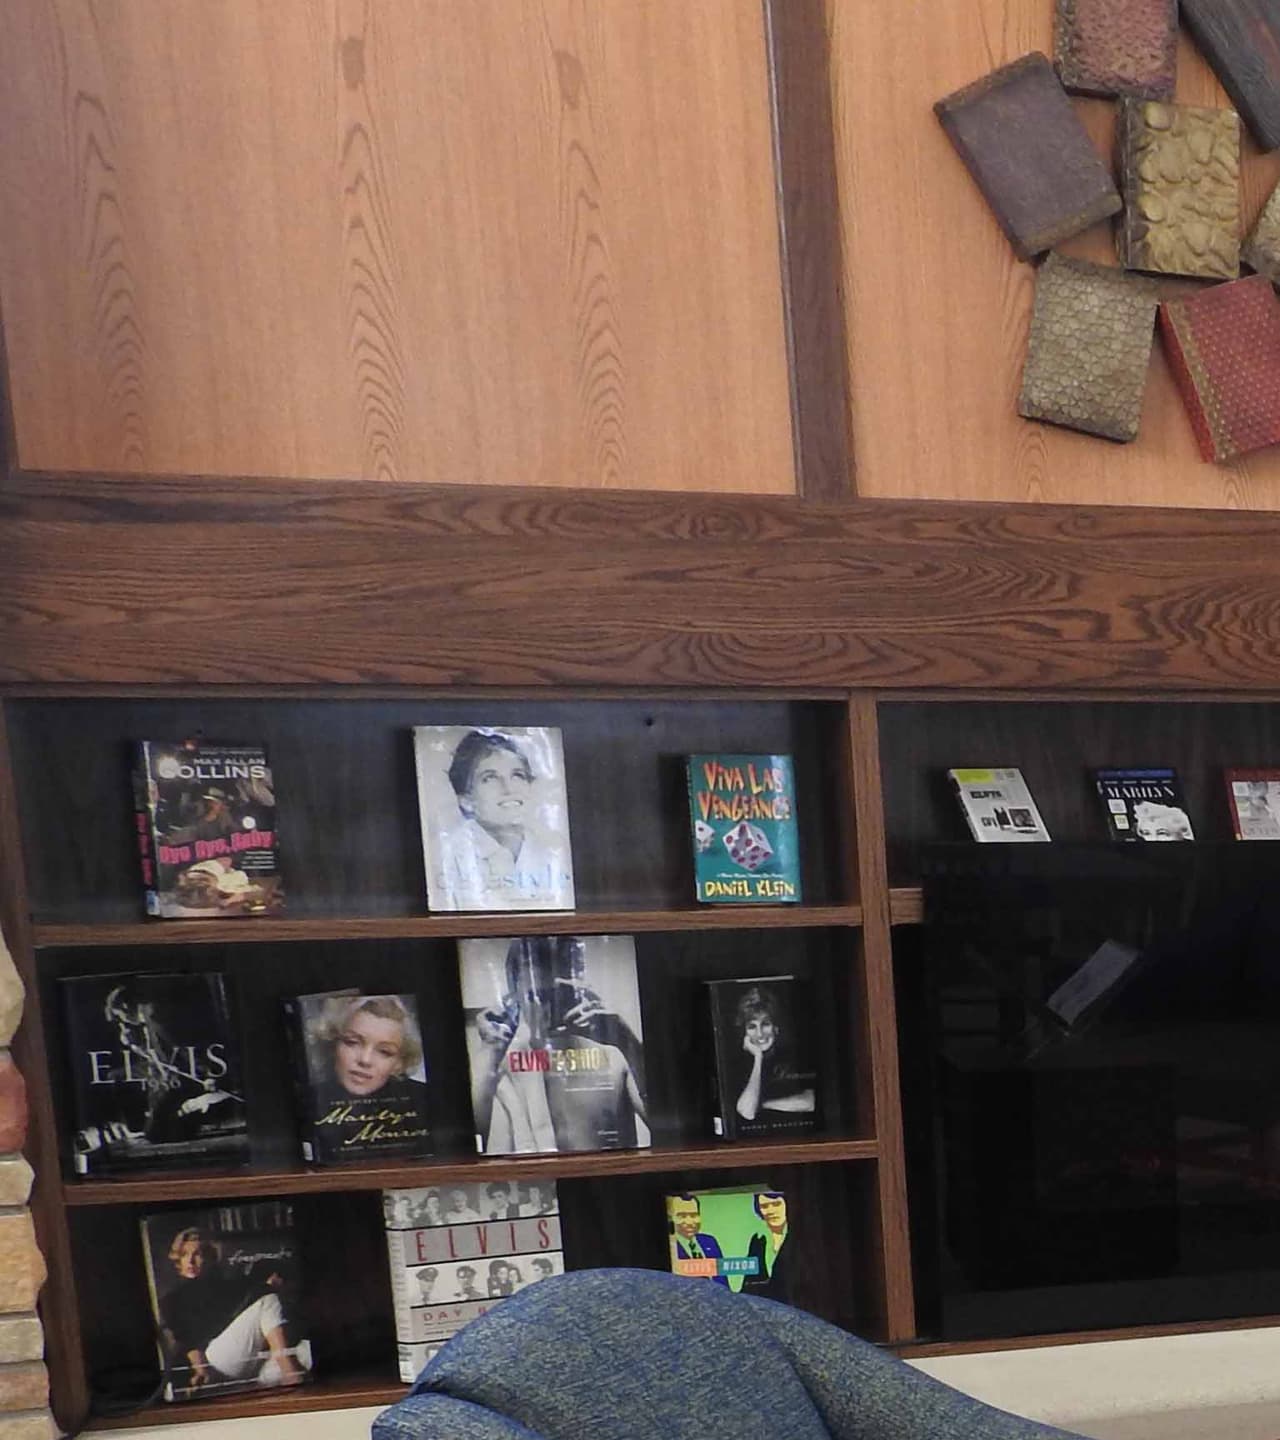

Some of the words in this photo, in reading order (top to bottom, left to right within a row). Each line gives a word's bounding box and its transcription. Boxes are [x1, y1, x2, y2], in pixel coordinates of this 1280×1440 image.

[747, 763, 785, 794] LAS
[1107, 786, 1175, 798] MARILYN
[697, 791, 791, 821] VENGEANCE
[705, 880, 752, 897] DANIEL
[88, 1044, 228, 1084] ELVIS
[509, 1049, 550, 1072] ELVIS
[314, 1105, 418, 1125] Marilyn
[344, 1122, 430, 1145] Monroe
[415, 1219, 550, 1262] ELVIS
[722, 1260, 755, 1271] NIXON
[423, 1310, 462, 1322] DAY
